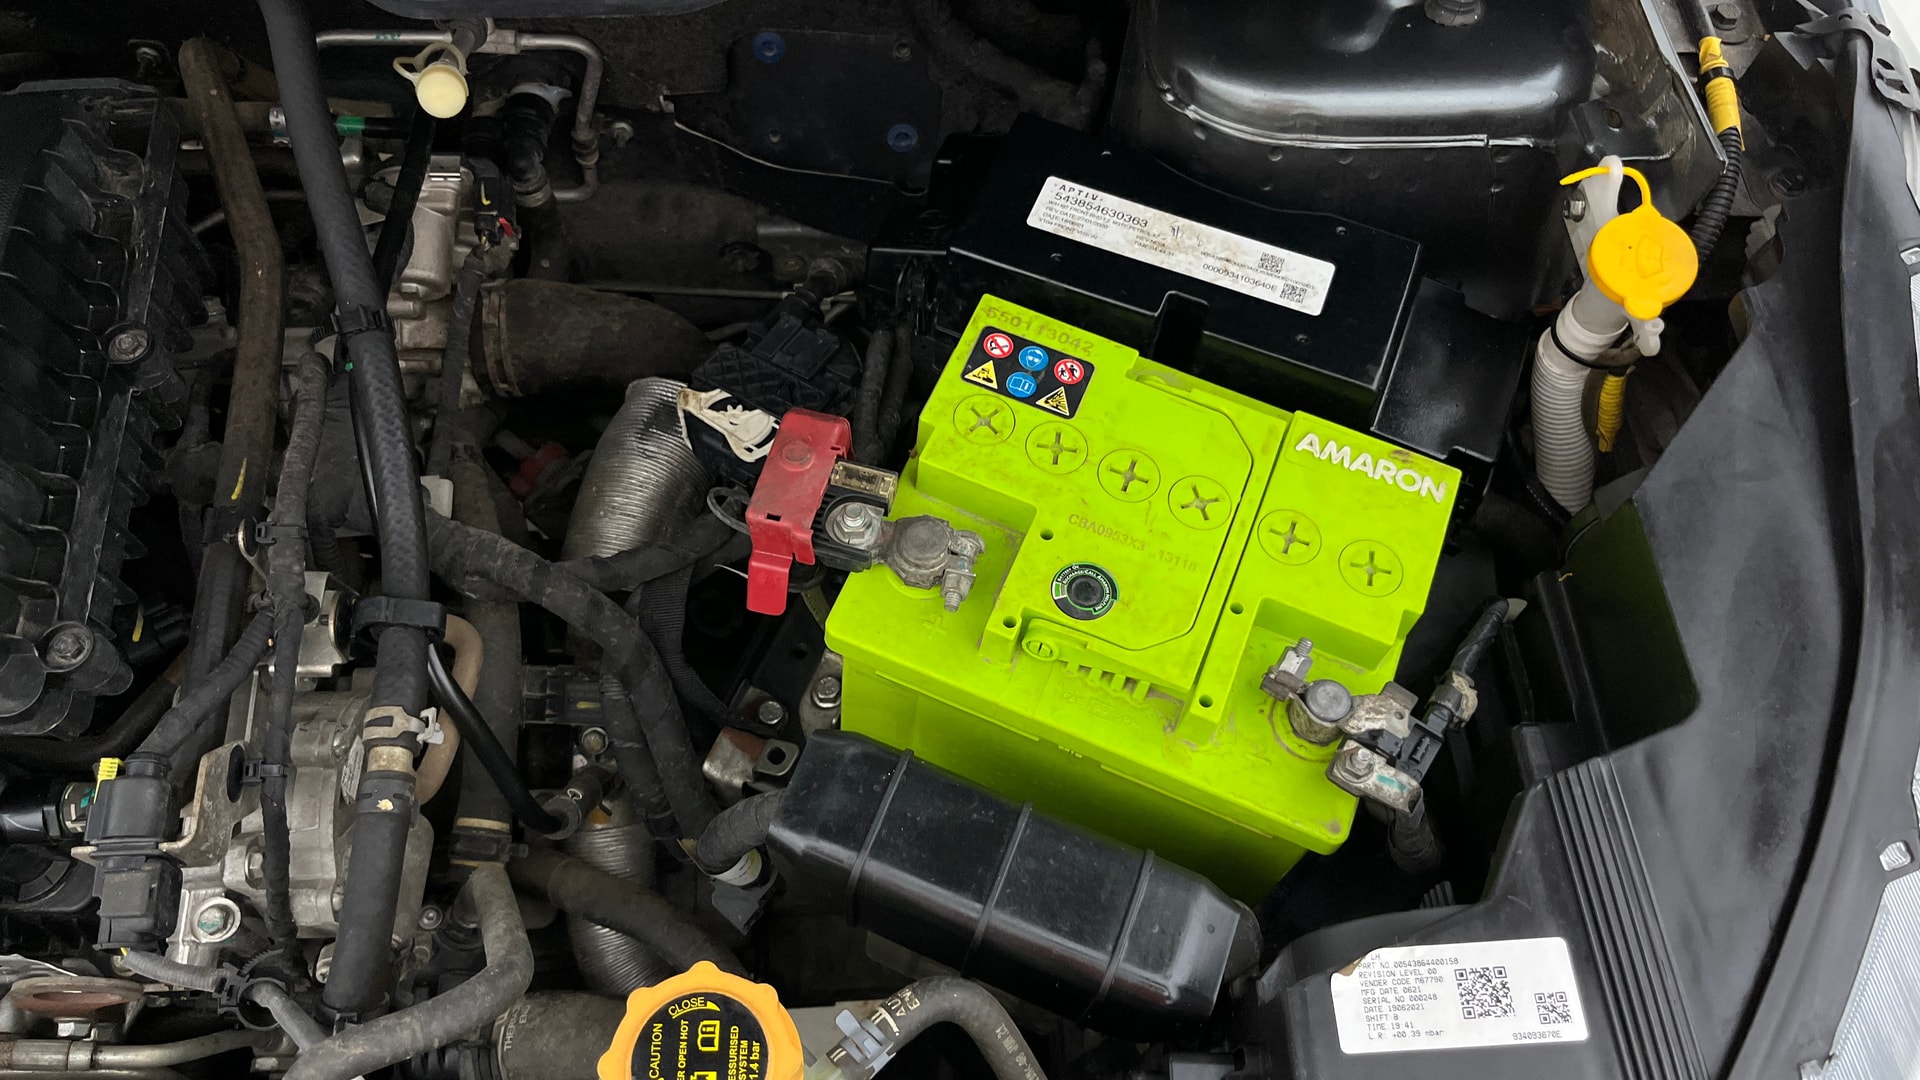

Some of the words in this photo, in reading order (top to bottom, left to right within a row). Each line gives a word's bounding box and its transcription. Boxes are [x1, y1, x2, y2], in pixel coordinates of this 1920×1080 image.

[1055, 192, 1148, 228] 543854630363
[1296, 433, 1447, 503] AMARON
[1359, 970, 1396, 978] REVISION
[1360, 979, 1388, 987] VENDER
[1361, 988, 1376, 996] MFG
[1362, 997, 1391, 1005] SERIAL
[668, 996, 706, 1017] CLOSE
[680, 1019, 690, 1040] HOT
[649, 1023, 664, 1079] CAUTION
[677, 1041, 688, 1069] OPEN
[738, 1040, 749, 1080] SYSTEM
[749, 1040, 761, 1060] bar
[748, 1062, 760, 1080] 1.4
